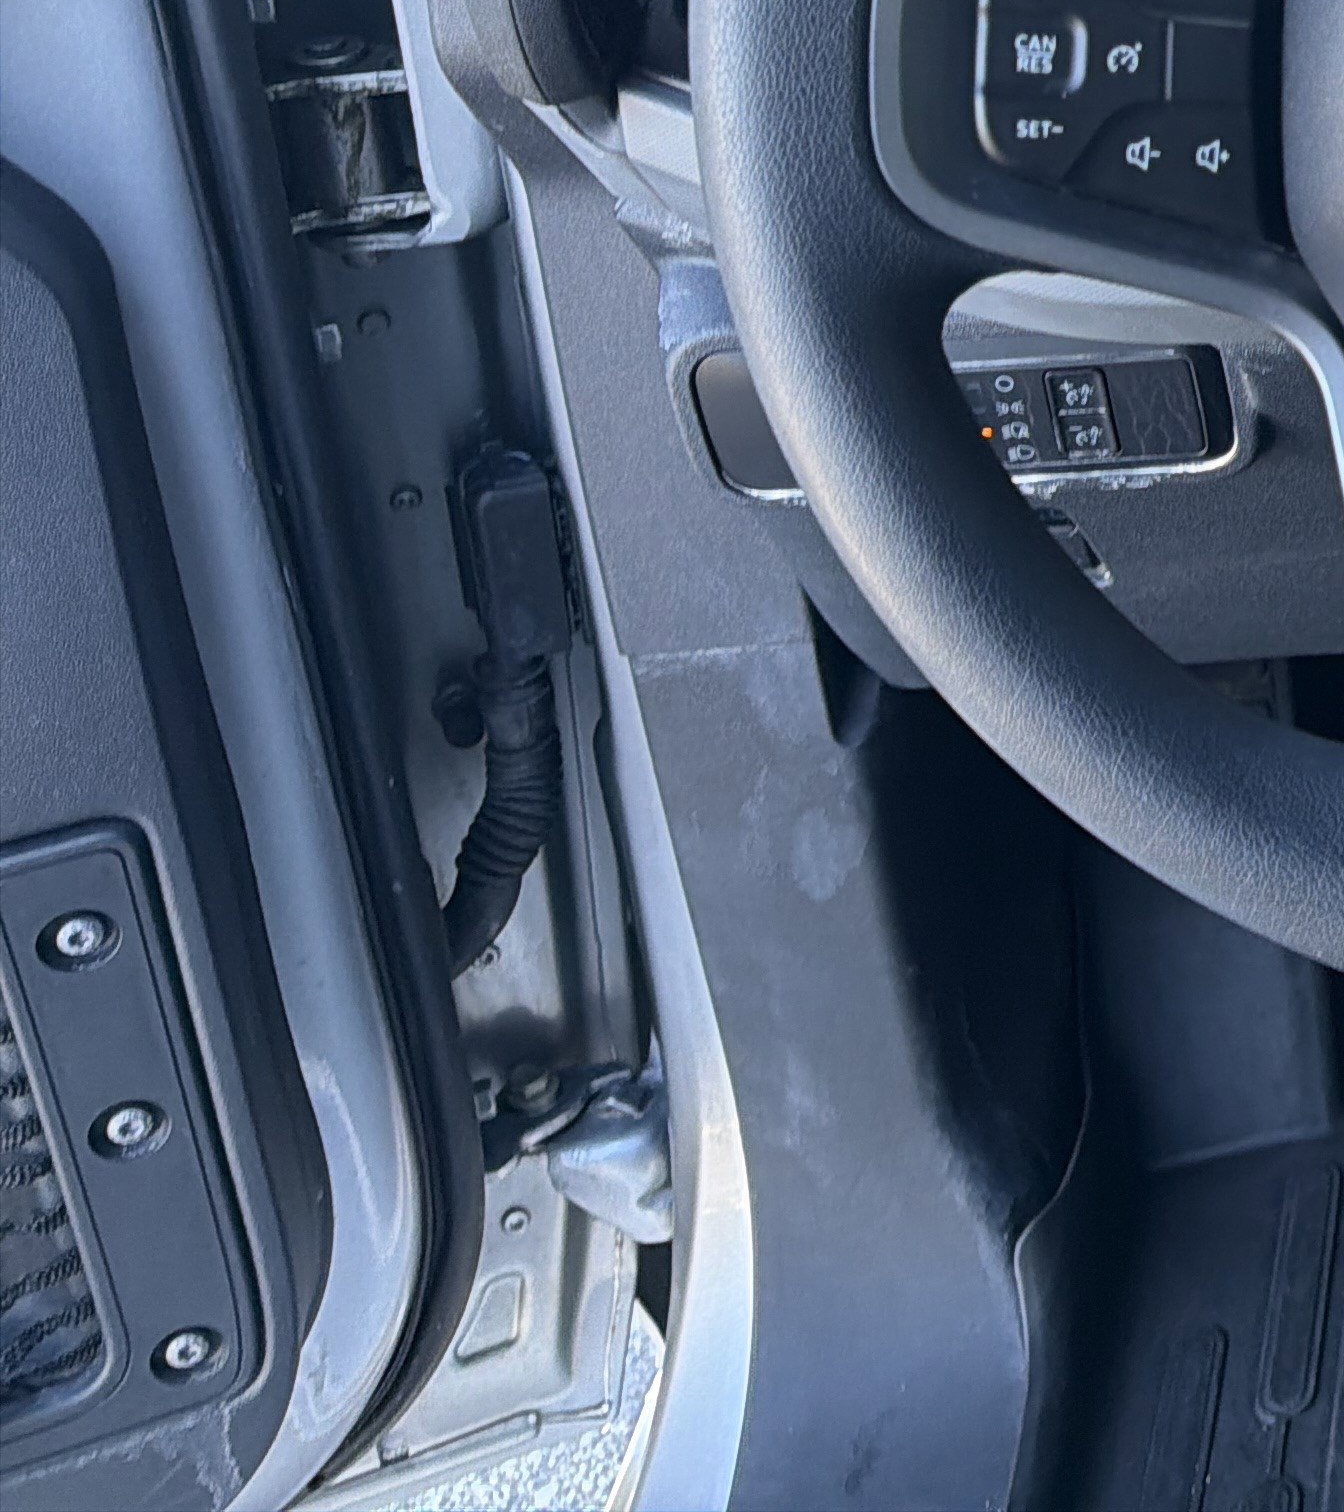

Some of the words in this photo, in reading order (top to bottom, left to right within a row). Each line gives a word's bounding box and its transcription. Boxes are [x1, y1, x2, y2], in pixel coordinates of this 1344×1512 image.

[1014, 33, 1056, 52] CAN
[1016, 53, 1052, 74] RES
[1017, 119, 1064, 138] SET-
